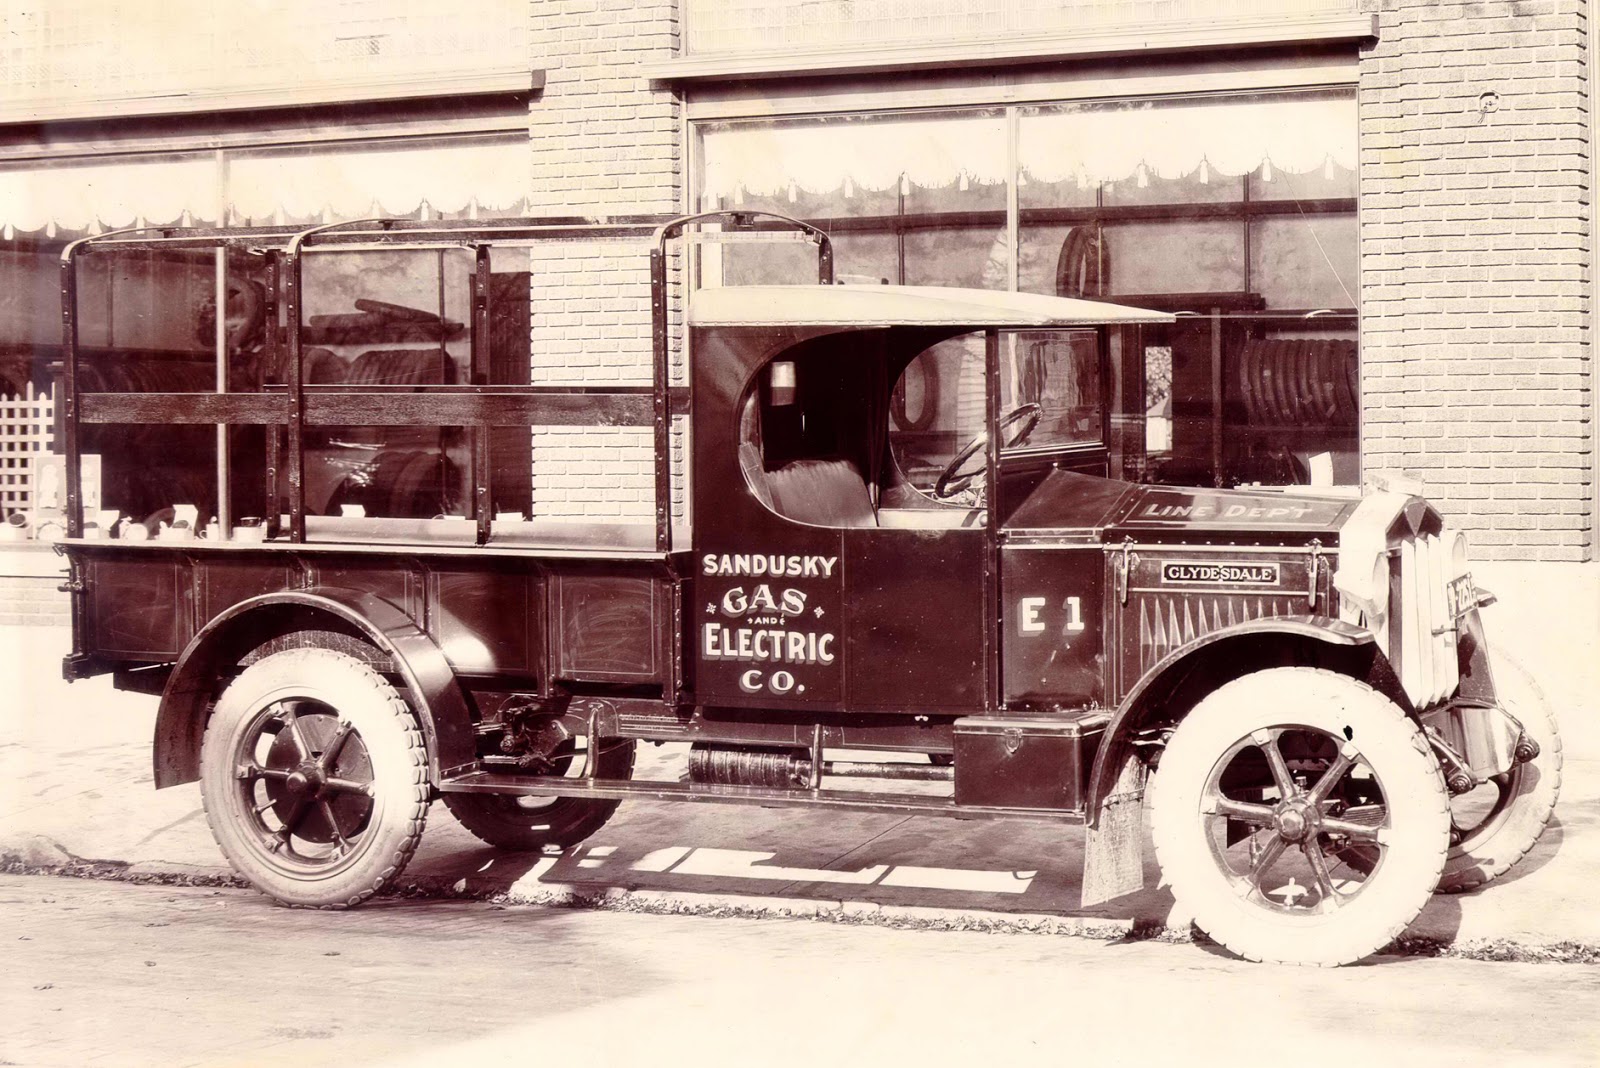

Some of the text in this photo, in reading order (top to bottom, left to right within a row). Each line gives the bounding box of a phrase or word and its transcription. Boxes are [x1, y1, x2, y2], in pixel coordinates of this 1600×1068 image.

[1144, 503, 1213, 517] LINE
[703, 554, 837, 577] SANDUSKY
[1168, 566, 1273, 581] CLYDESDALE
[721, 584, 807, 617] GAS
[754, 616, 778, 625] AND
[1020, 596, 1085, 633] E 1
[704, 622, 835, 663] ELECTRIC
[741, 669, 806, 692] CO.
